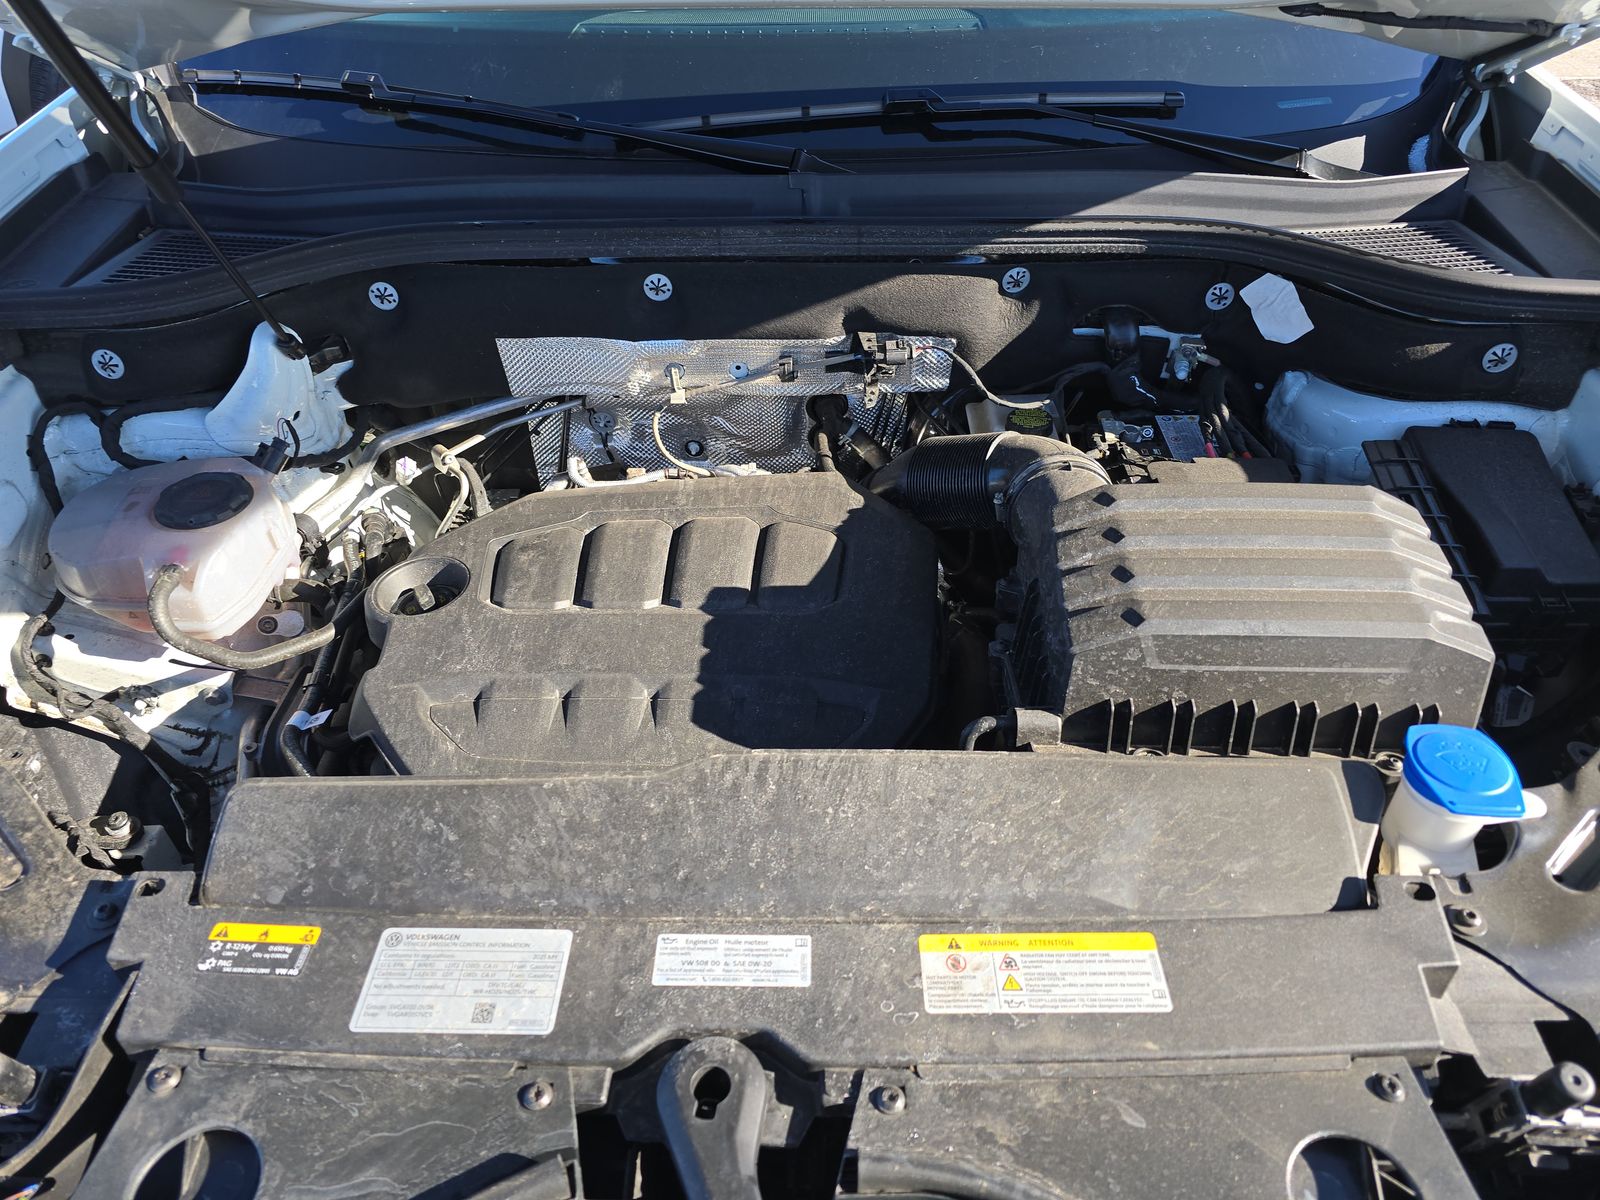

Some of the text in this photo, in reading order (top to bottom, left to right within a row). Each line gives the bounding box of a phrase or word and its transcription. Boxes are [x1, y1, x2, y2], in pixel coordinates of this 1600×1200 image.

[979, 939, 1075, 947] WARNING ATTENTION
[217, 959, 232, 967] PAG
